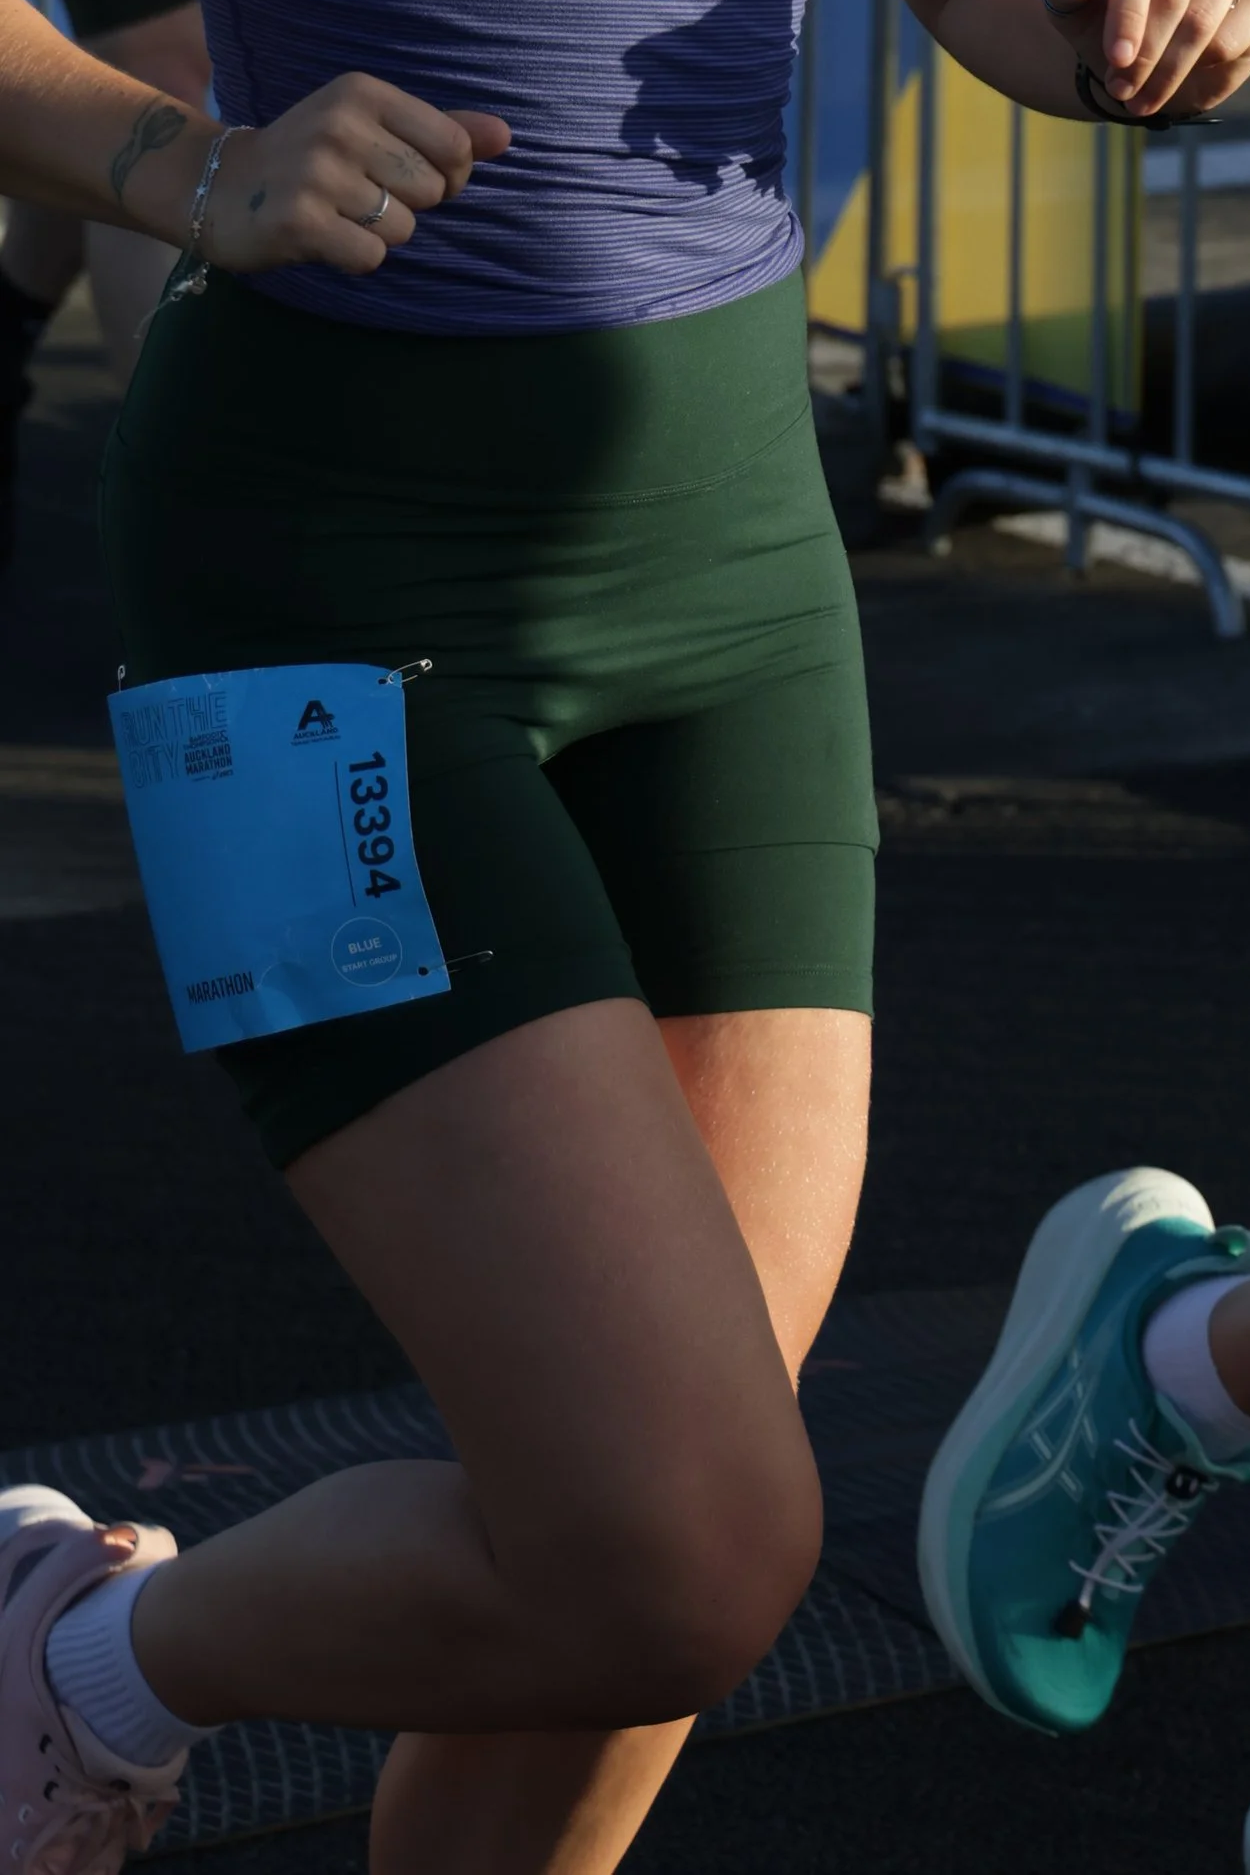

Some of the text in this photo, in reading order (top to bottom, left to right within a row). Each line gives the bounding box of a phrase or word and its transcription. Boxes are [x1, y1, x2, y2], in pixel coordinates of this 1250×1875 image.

[167, 691, 228, 735] THE
[184, 743, 231, 764] AUCKLAND
[185, 755, 233, 776] MARATHON
[349, 751, 402, 899] 13394
[348, 937, 383, 955] BLUE
[342, 953, 398, 974] START GROUP
[187, 971, 255, 1005] MARATHON
